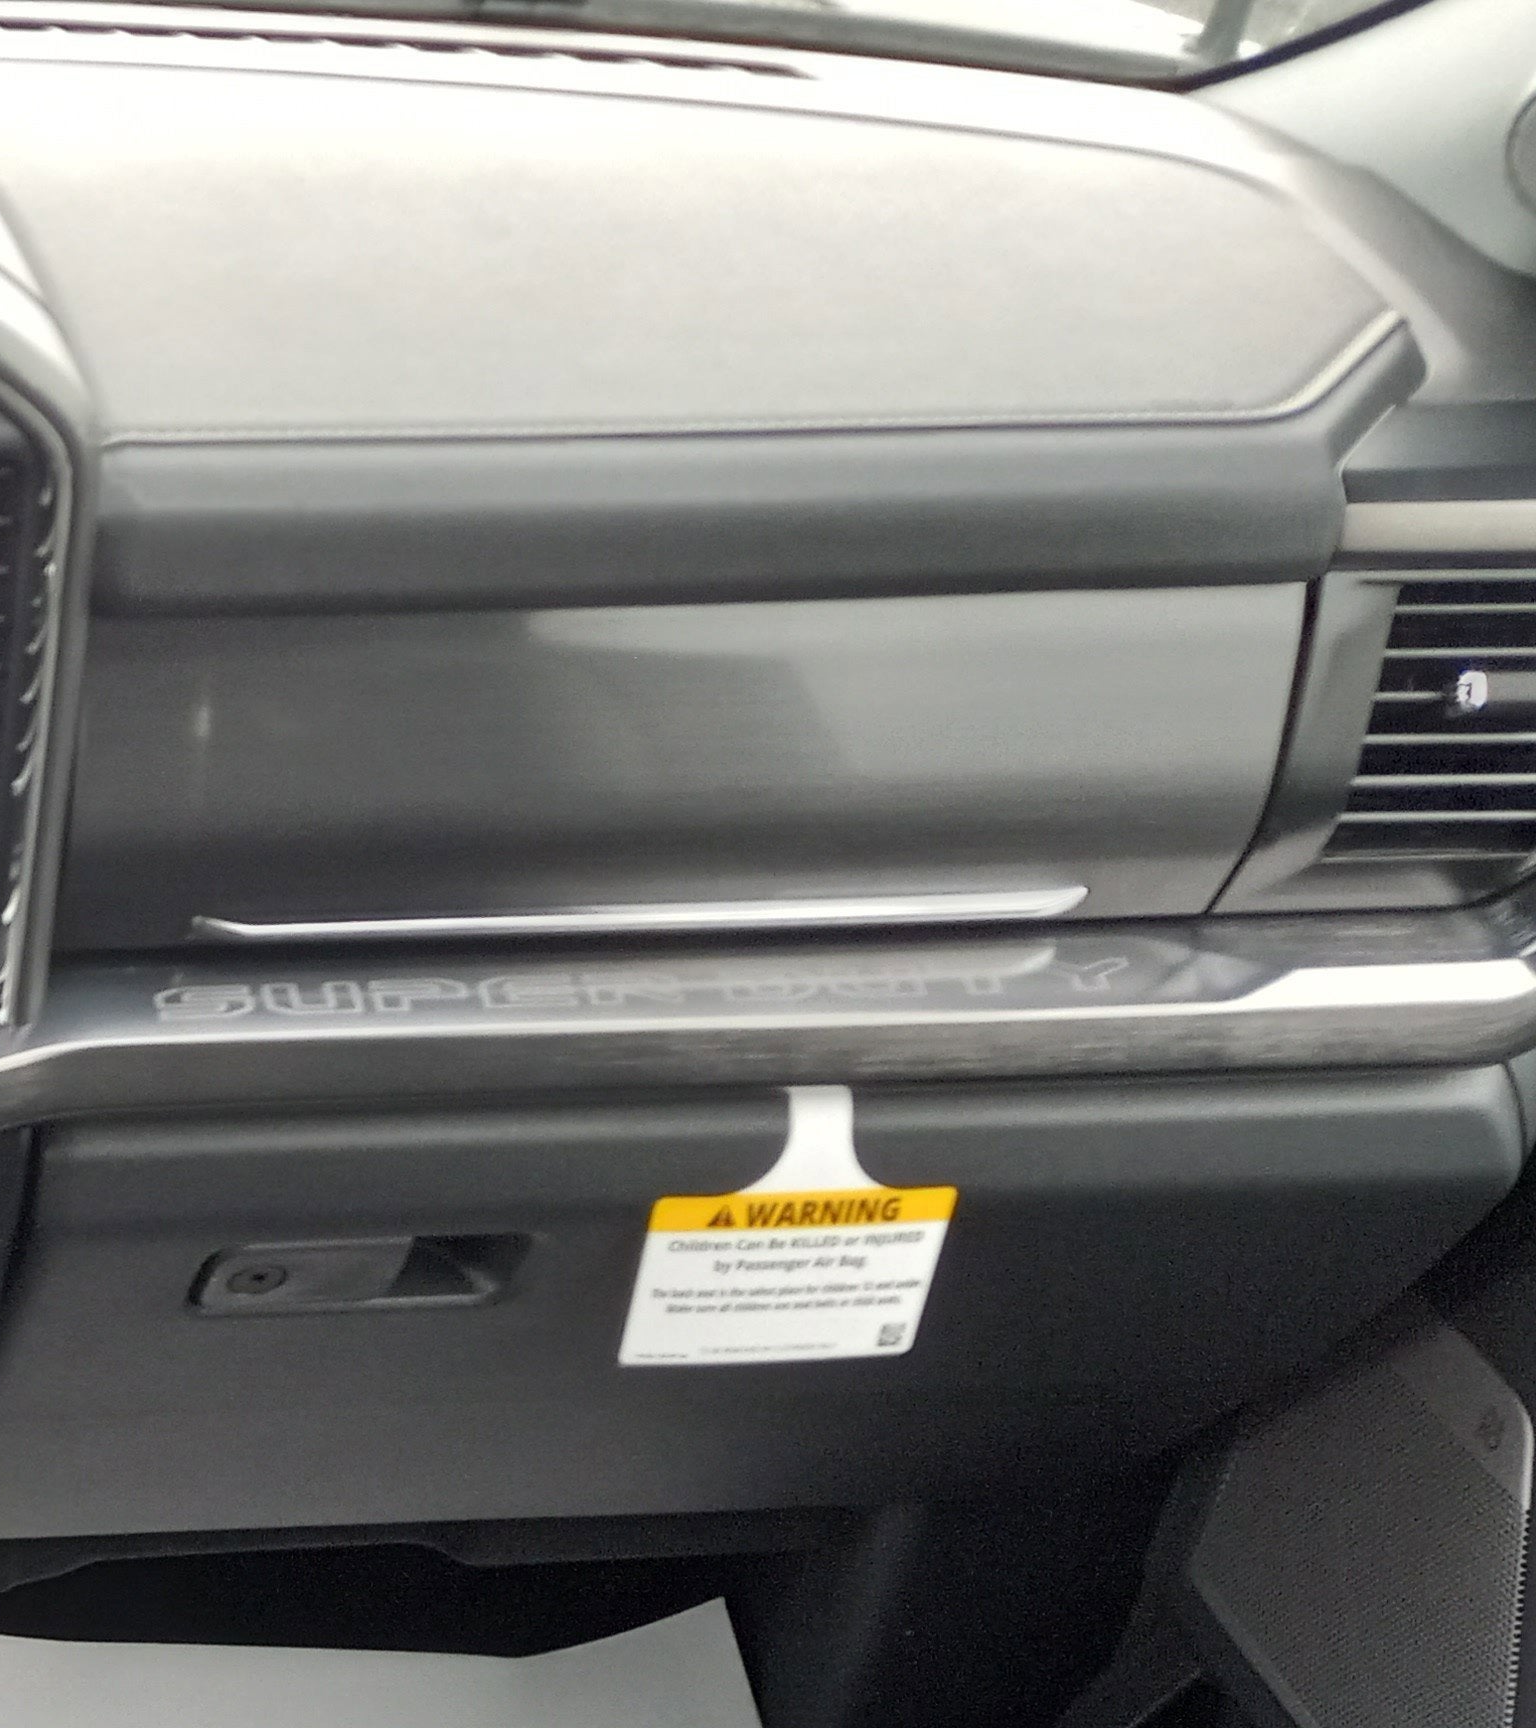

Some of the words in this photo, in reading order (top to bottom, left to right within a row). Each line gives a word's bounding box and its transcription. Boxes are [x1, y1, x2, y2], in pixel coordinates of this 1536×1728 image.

[745, 1198, 903, 1228] WARNING
[668, 1238, 732, 1253] Children
[735, 1238, 765, 1252] Can
[735, 1257, 812, 1273] Passenger
[814, 1256, 836, 1268] Air
